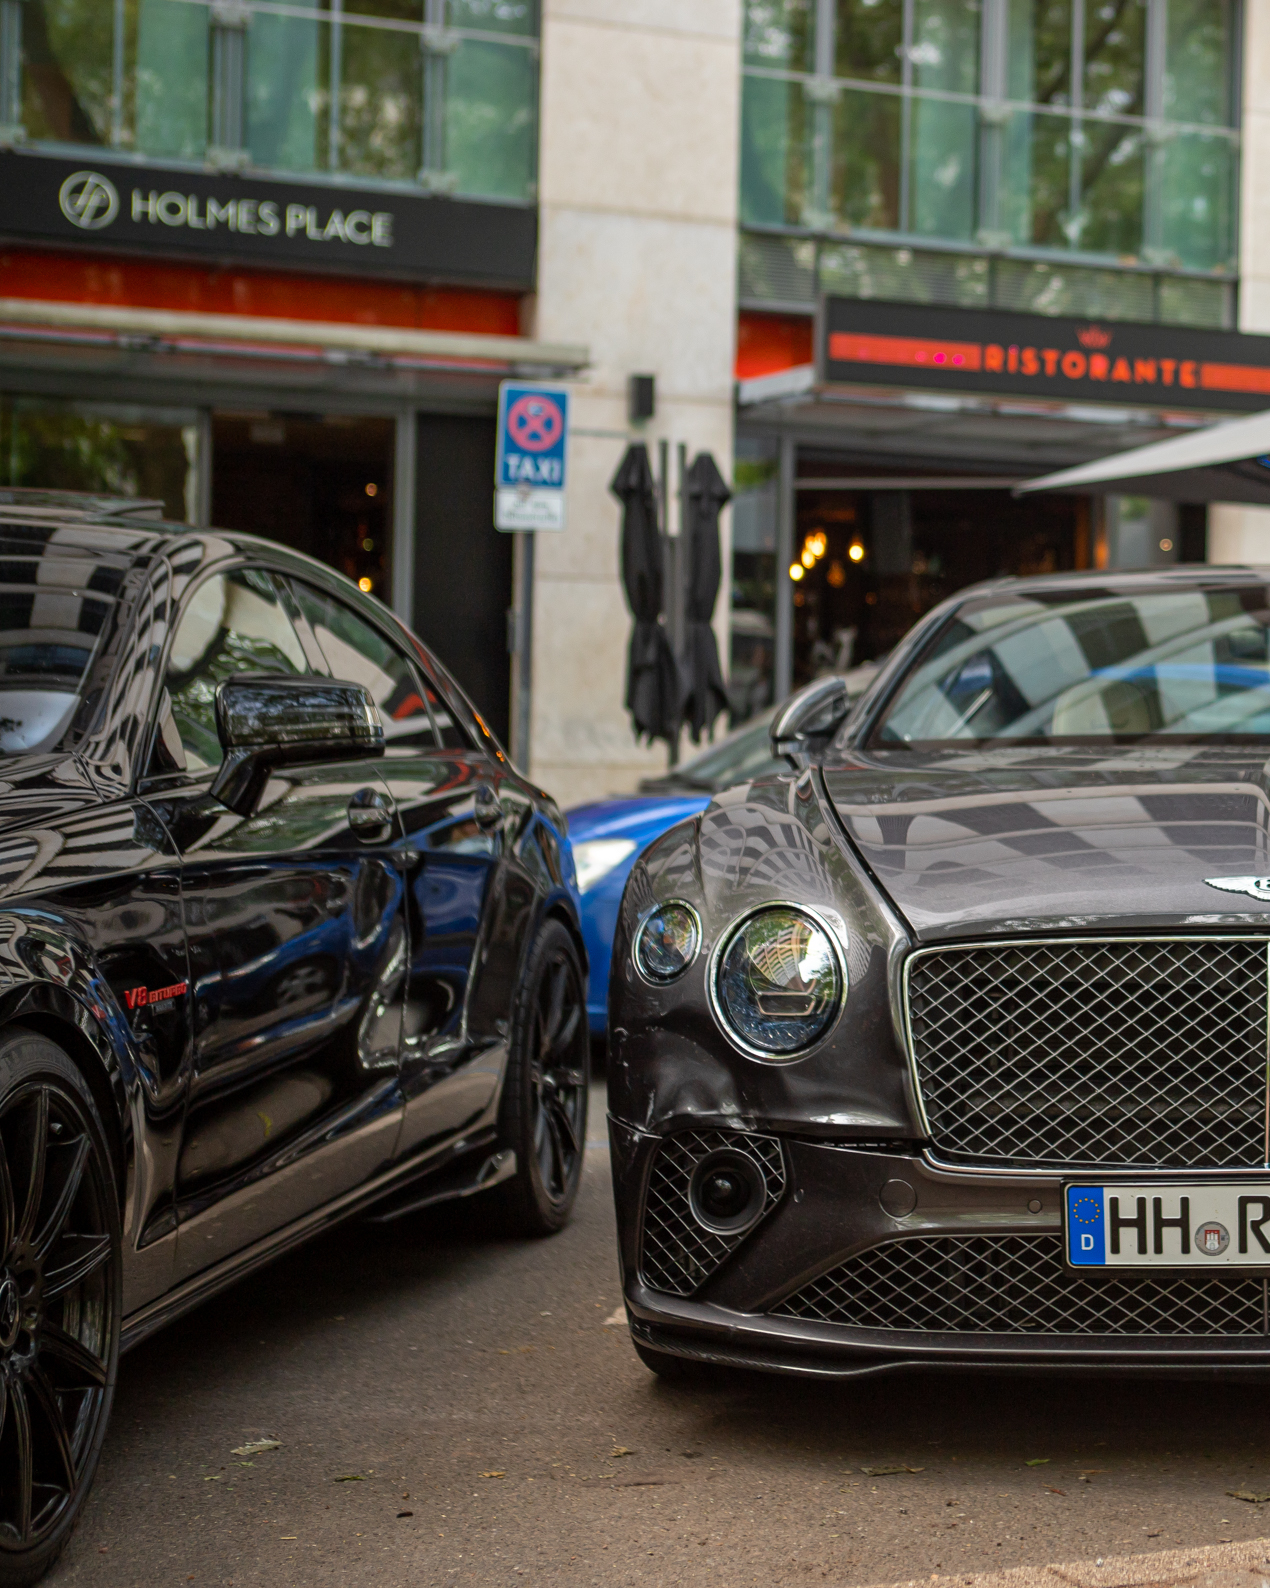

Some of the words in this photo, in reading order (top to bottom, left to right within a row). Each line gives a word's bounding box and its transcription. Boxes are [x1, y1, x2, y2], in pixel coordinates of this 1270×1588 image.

[131, 188, 280, 237] HOLMES
[285, 203, 395, 248] PLACE
[984, 343, 1197, 389] RISTORANTE
[506, 455, 562, 484] TAXI
[124, 986, 147, 1009] V8
[1080, 1234, 1095, 1250] D
[1108, 1195, 1191, 1255] HH
